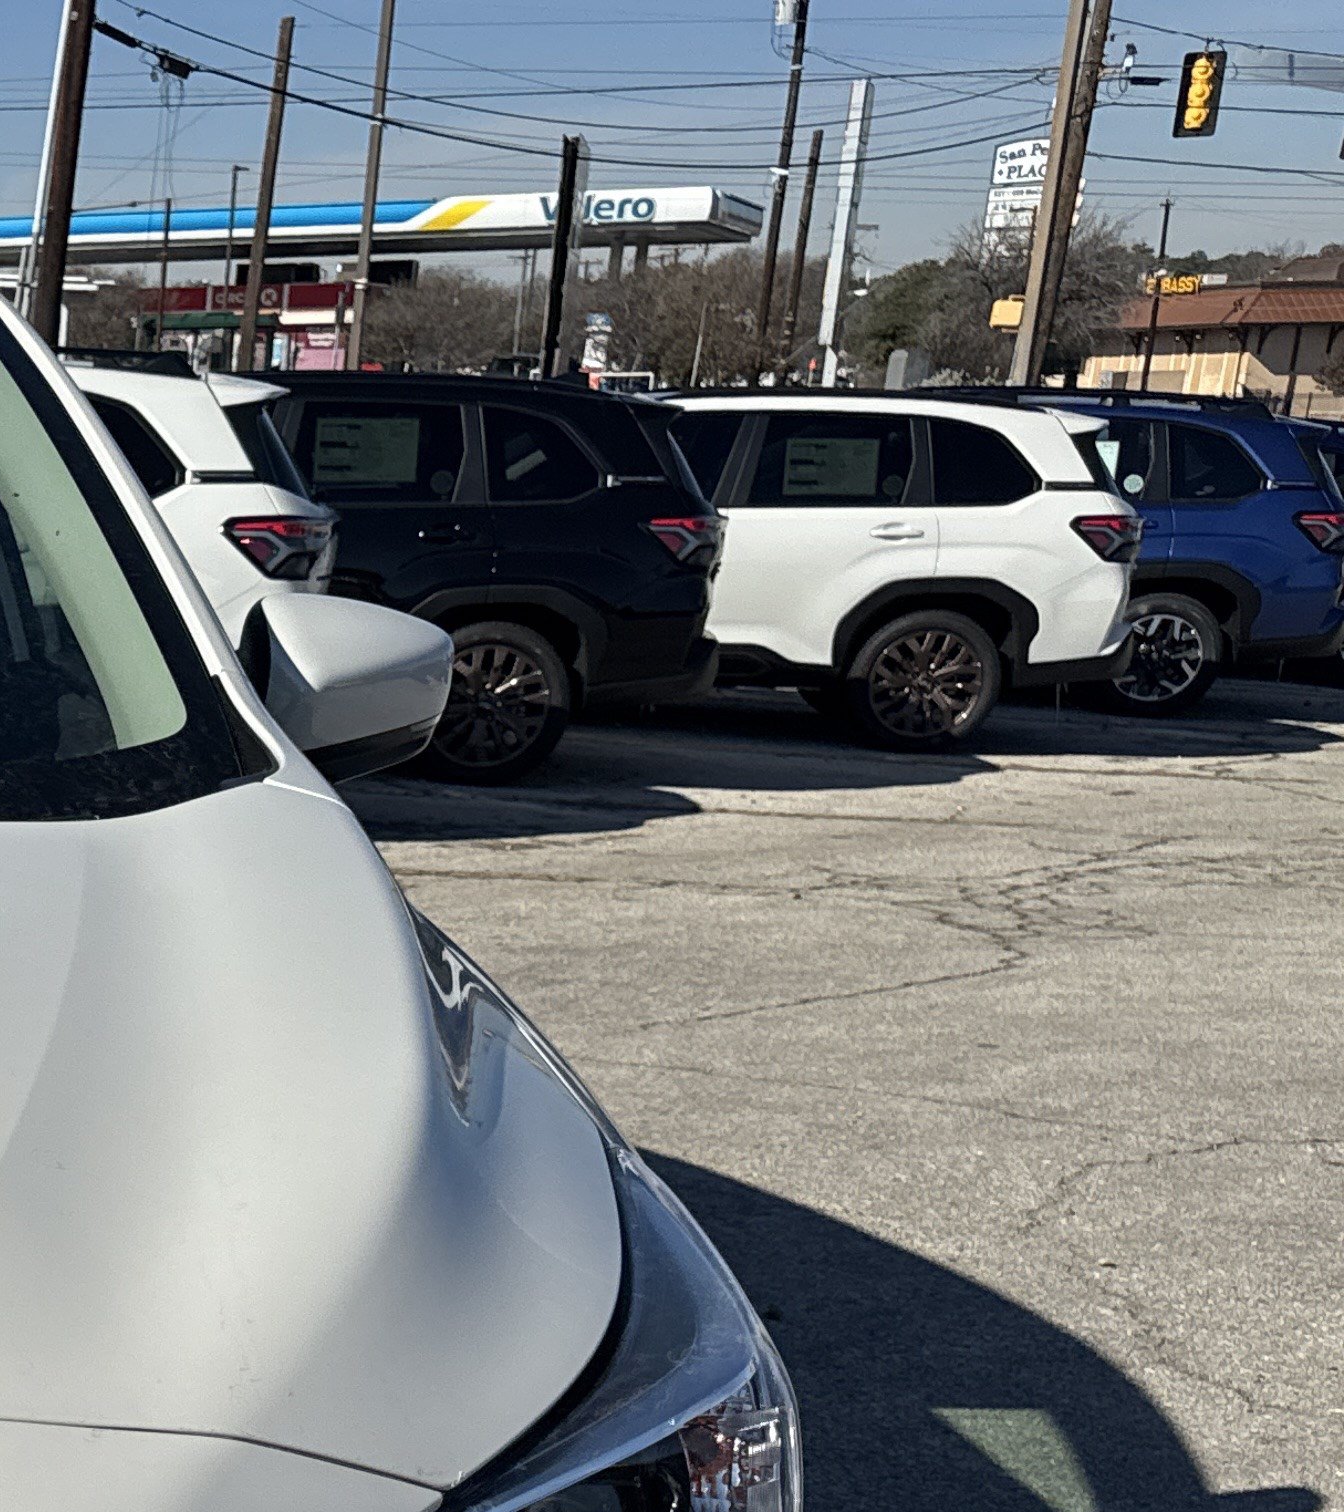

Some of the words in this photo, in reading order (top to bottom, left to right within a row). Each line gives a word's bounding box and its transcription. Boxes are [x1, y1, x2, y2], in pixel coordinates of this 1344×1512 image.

[999, 148, 1027, 164] San
[1006, 164, 1047, 179] PLAC
[540, 194, 654, 220] Vlero
[1145, 273, 1202, 294] EBASSY
